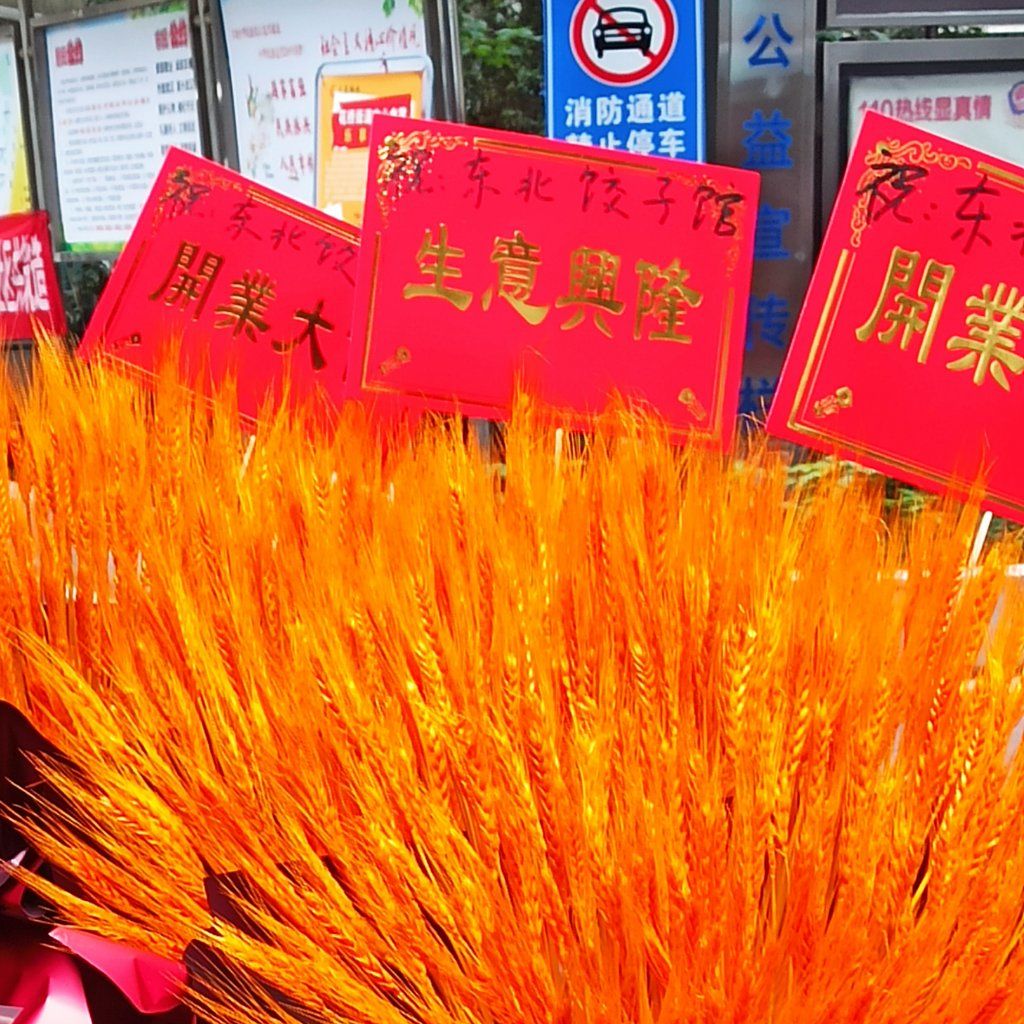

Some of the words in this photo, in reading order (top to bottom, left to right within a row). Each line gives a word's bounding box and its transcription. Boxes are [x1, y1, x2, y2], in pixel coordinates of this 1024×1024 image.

[564, 91, 686, 128] 消防通道
[148, 240, 351, 372] 開業大
[403, 223, 704, 344] 生意興隆
